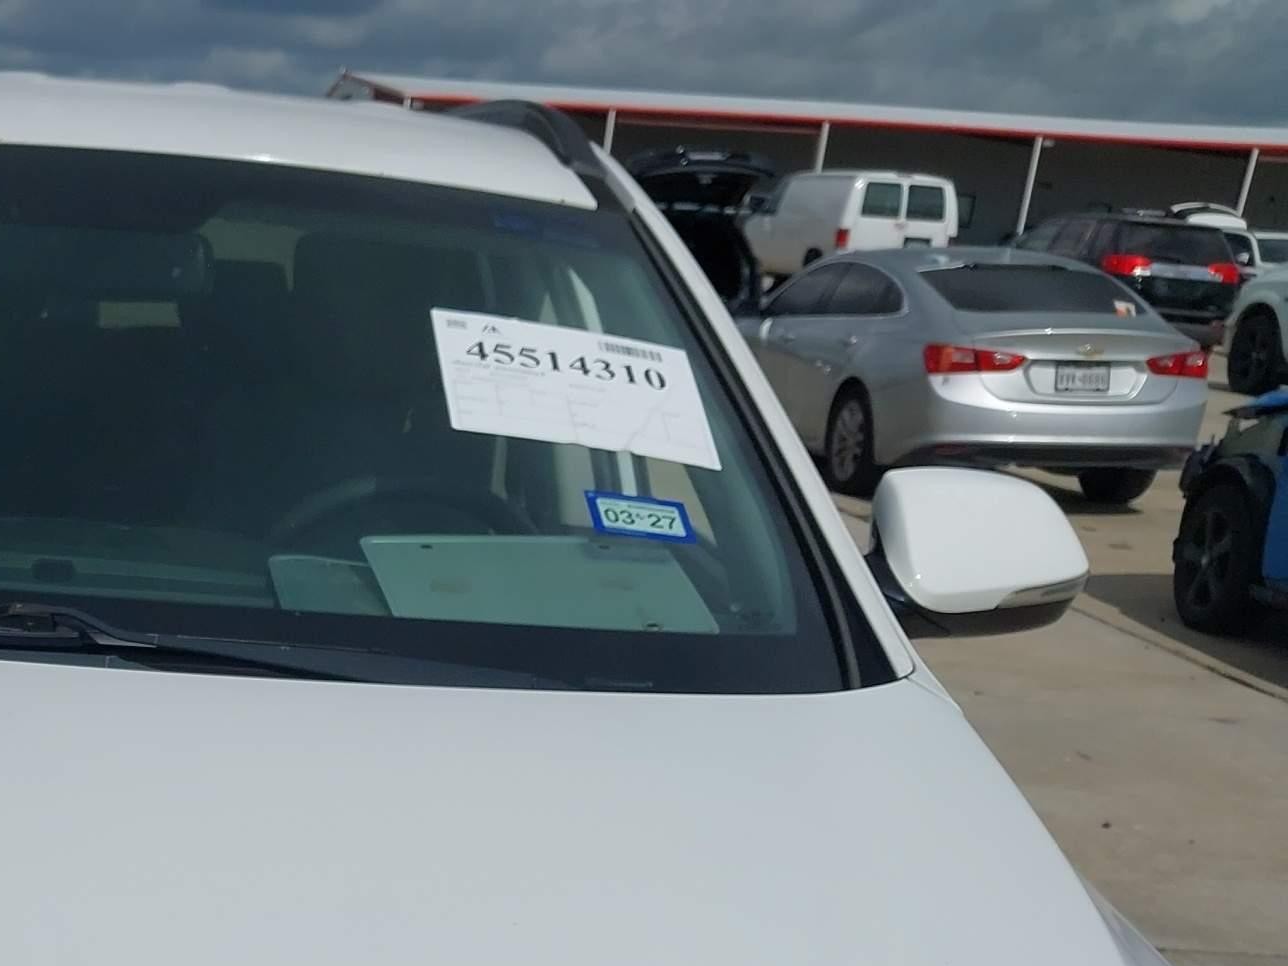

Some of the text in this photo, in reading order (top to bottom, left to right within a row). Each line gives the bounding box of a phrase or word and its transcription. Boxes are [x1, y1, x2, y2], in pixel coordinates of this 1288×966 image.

[466, 341, 667, 391] 45514310
[603, 507, 636, 526] 03
[647, 512, 677, 531] 27
